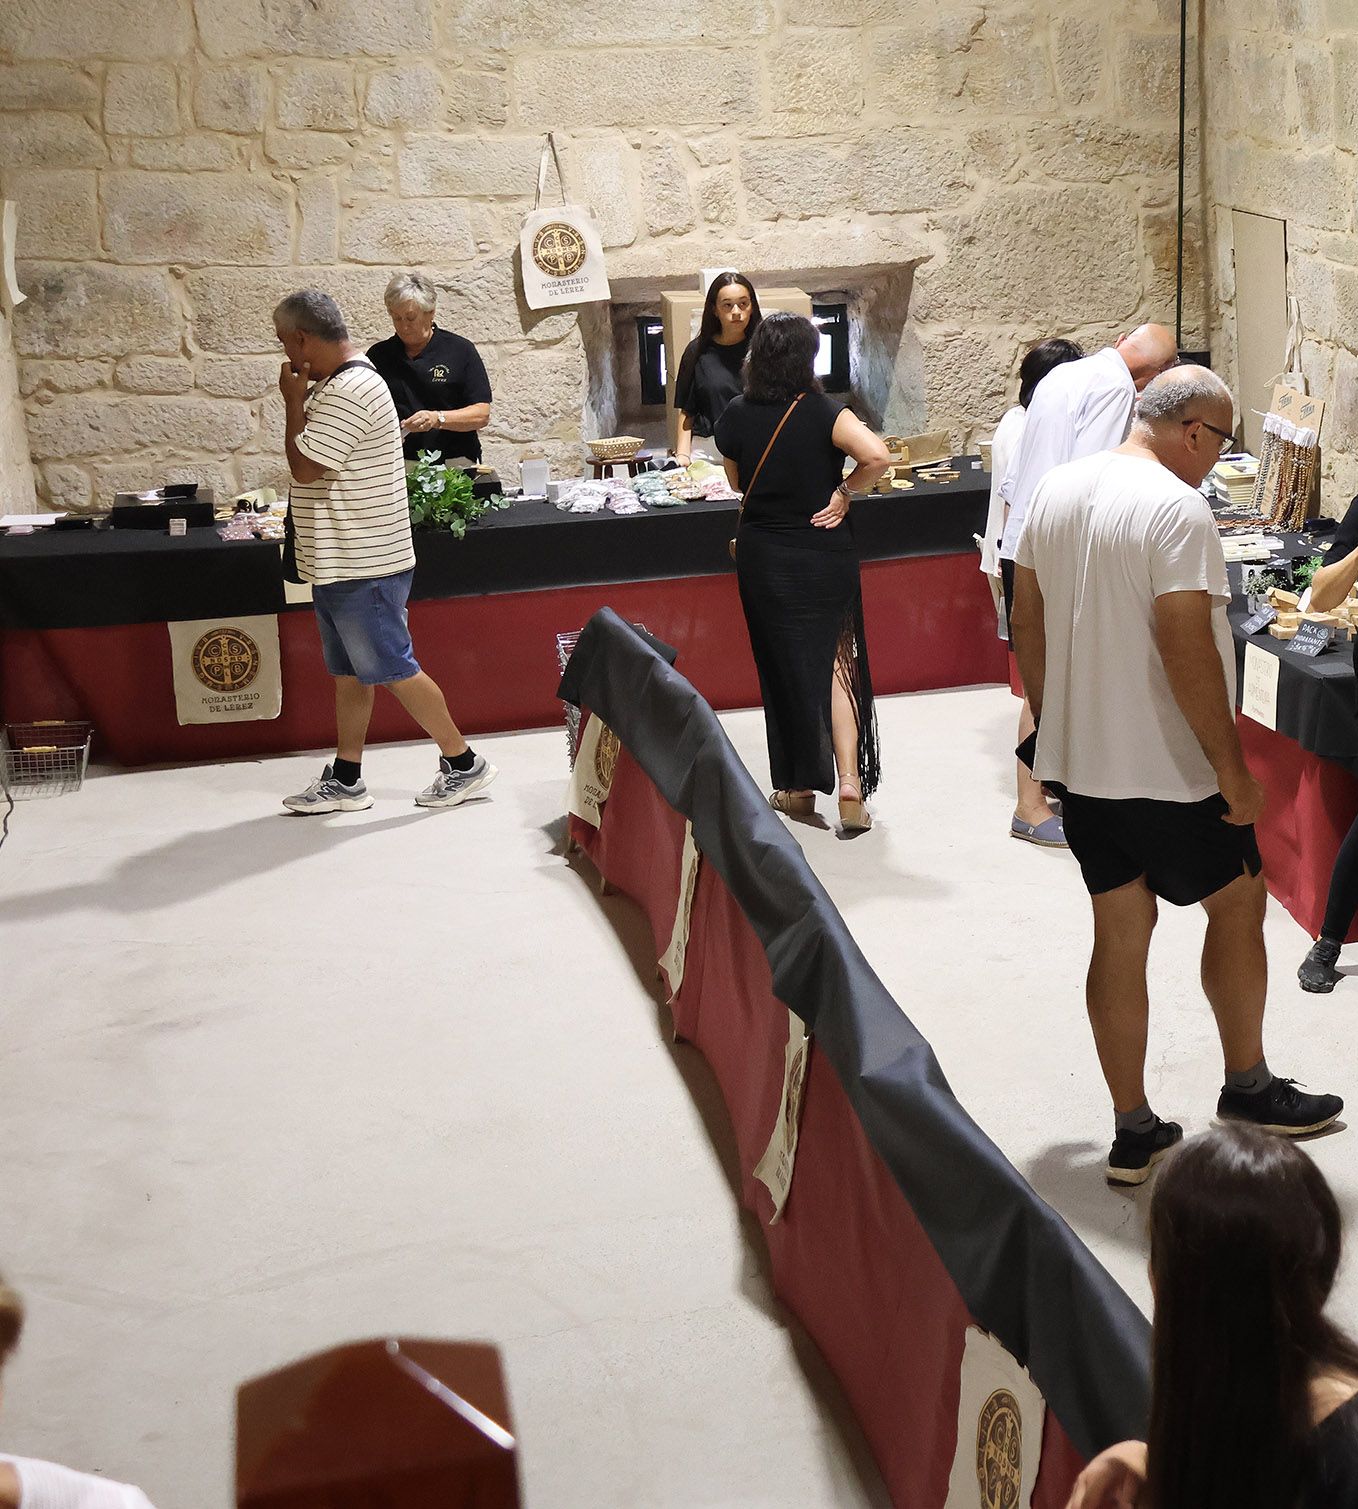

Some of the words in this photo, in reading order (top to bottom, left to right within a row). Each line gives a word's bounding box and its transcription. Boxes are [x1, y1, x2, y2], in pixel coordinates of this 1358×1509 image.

[541, 277, 589, 289] MONASTERIO
[1302, 623, 1318, 635] PACK
[201, 693, 260, 704] MONASTERIO
[210, 705, 221, 713] DE
